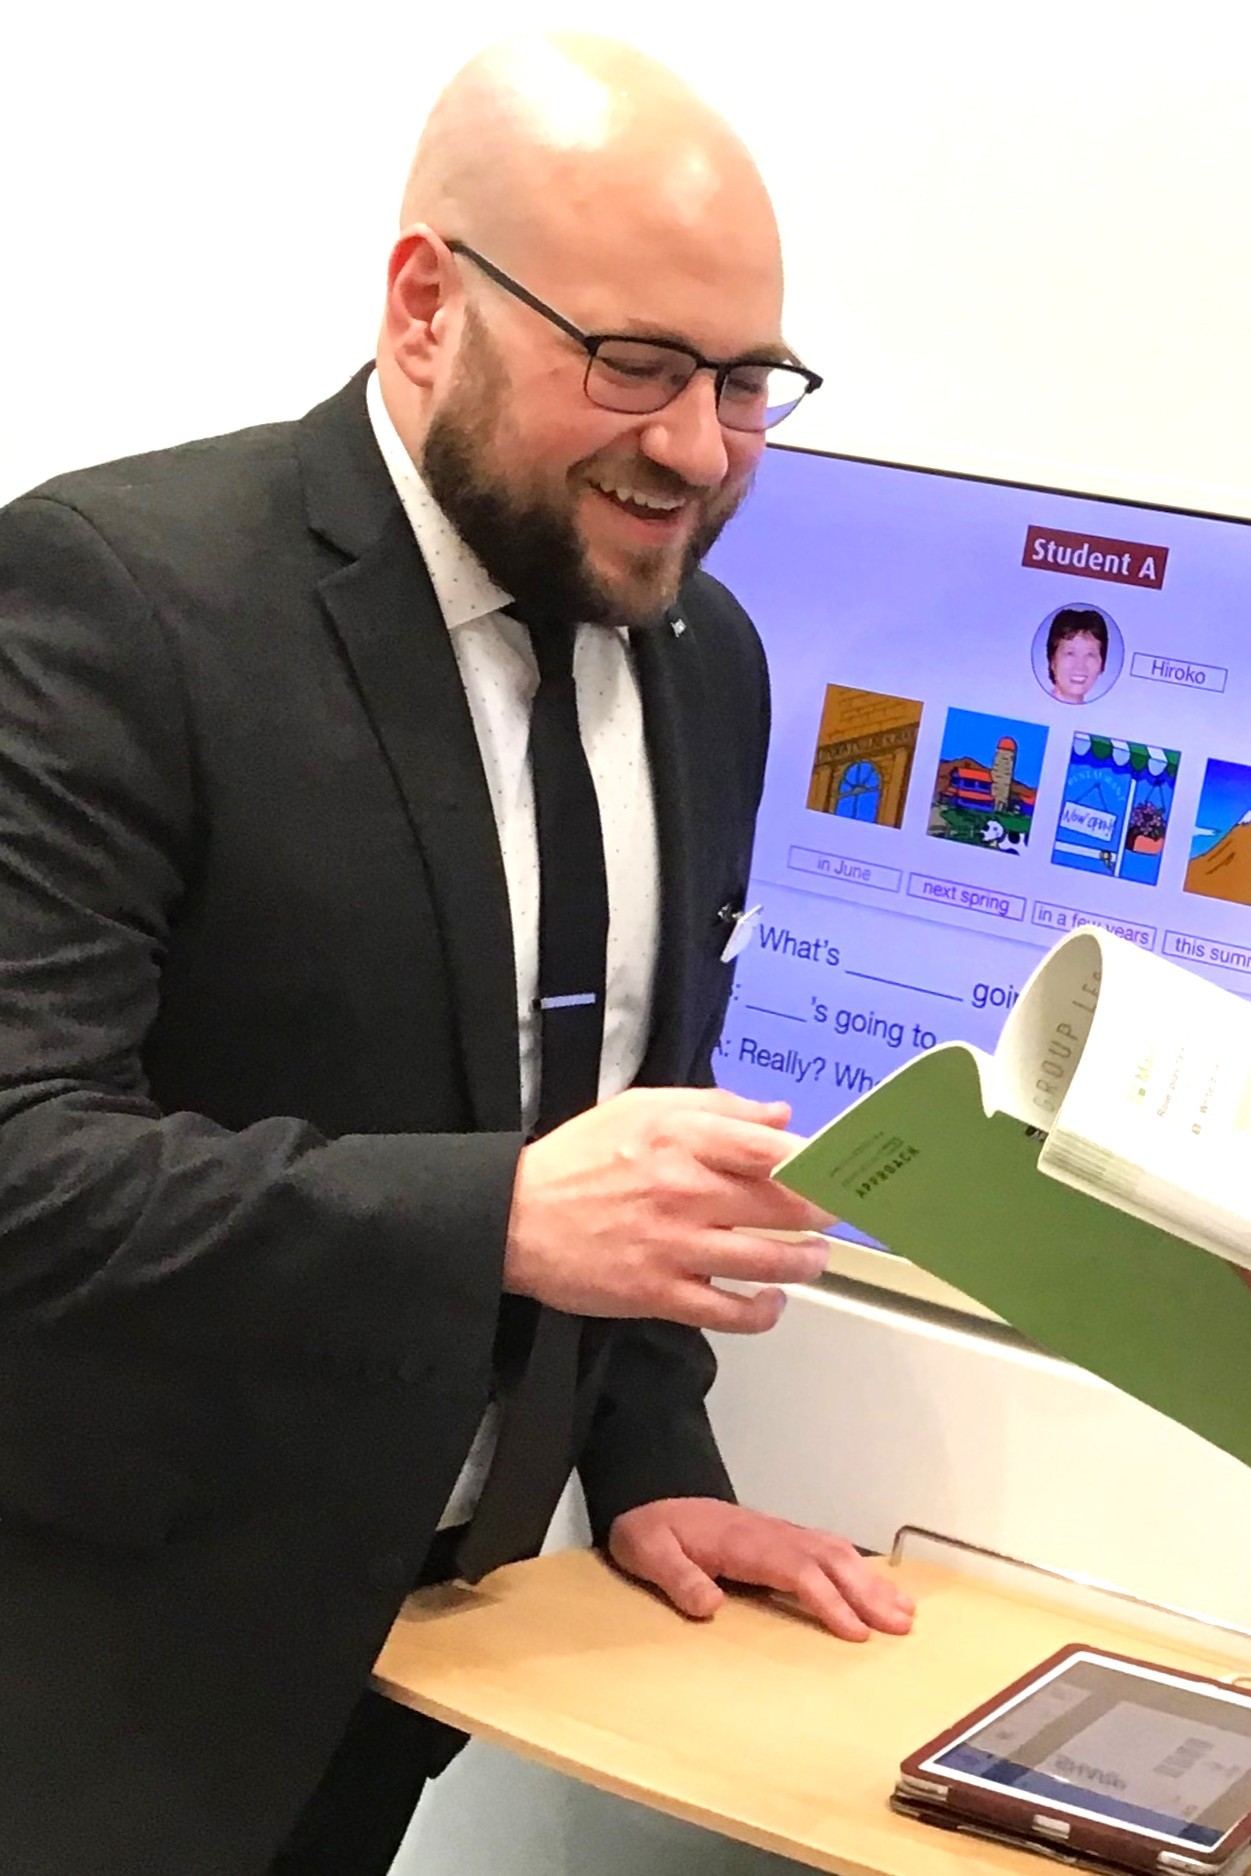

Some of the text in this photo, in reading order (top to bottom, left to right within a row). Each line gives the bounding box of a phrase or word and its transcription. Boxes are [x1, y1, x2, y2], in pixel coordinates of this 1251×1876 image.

[1031, 537, 1158, 582] Student A
[1150, 658, 1206, 686] Hiroko
[817, 856, 872, 882] in June
[923, 881, 1010, 916] next spring
[1037, 905, 1053, 923] in
[1056, 913, 1067, 926] a
[1175, 936, 1206, 957] this
[759, 923, 1020, 1009] What's goi
[834, 1010, 904, 1048] going
[912, 1023, 937, 1049] to
[738, 1037, 826, 1083] Really?
[834, 1061, 881, 1094] Wh
[1032, 1021, 1078, 1113] GROUP
